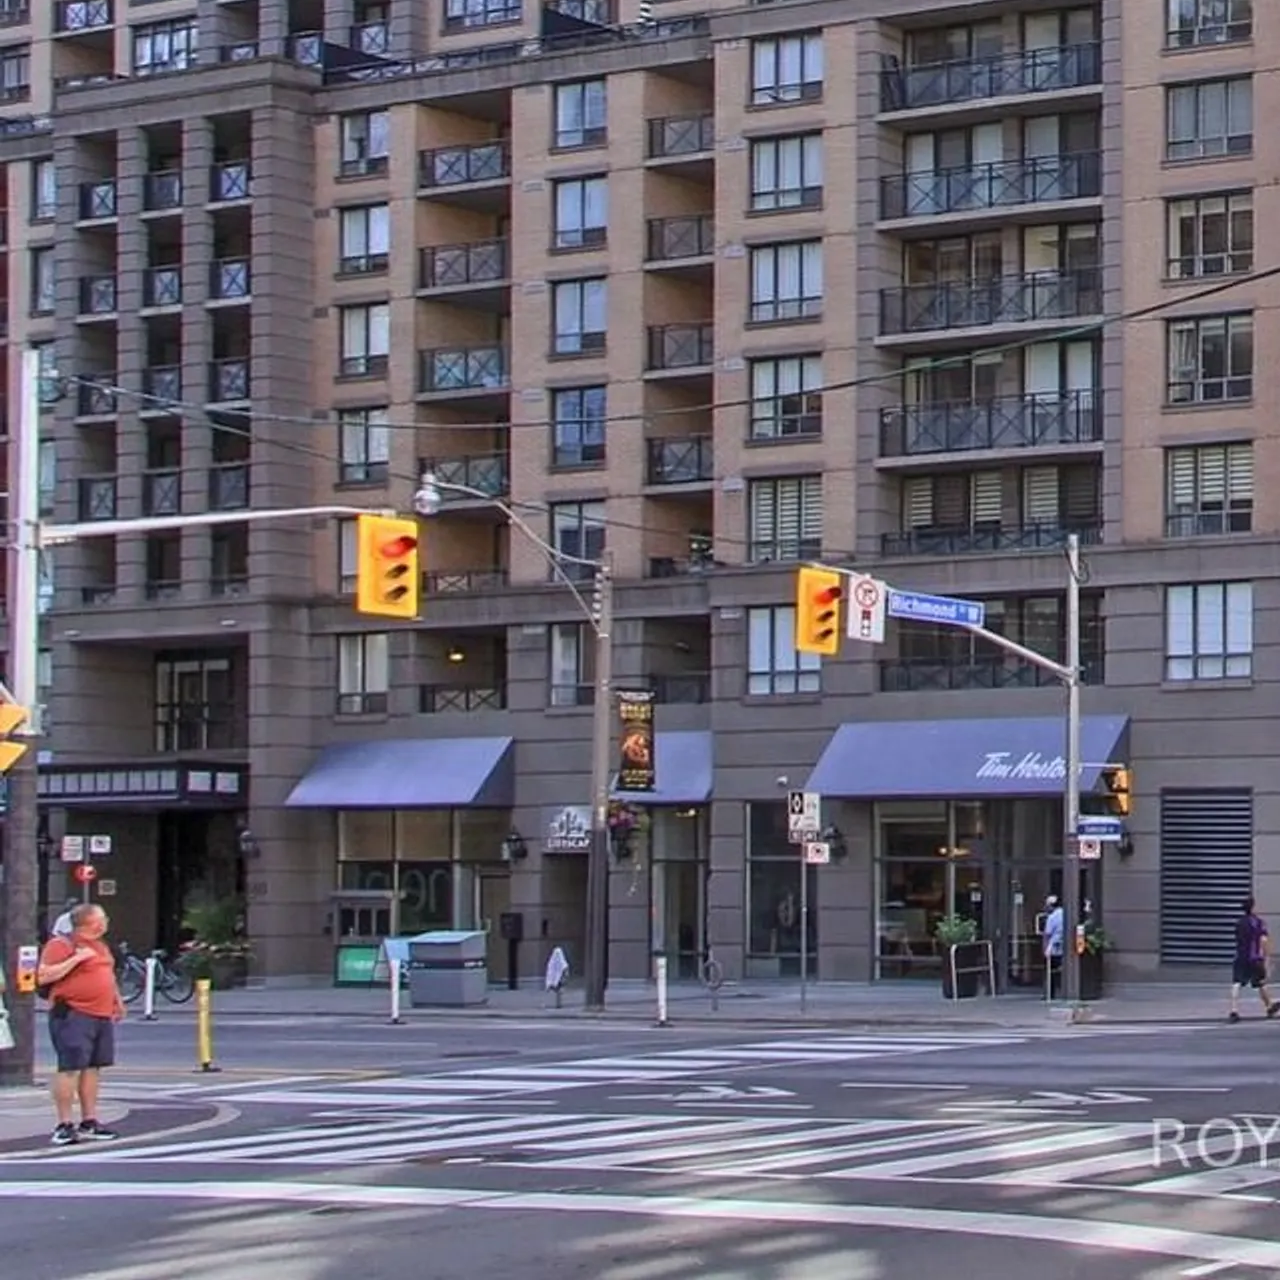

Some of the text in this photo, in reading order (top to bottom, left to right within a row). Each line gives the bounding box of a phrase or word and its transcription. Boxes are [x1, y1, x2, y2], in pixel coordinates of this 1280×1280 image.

[891, 593, 957, 619] Richmond
[976, 751, 1082, 779] Tim Horto
